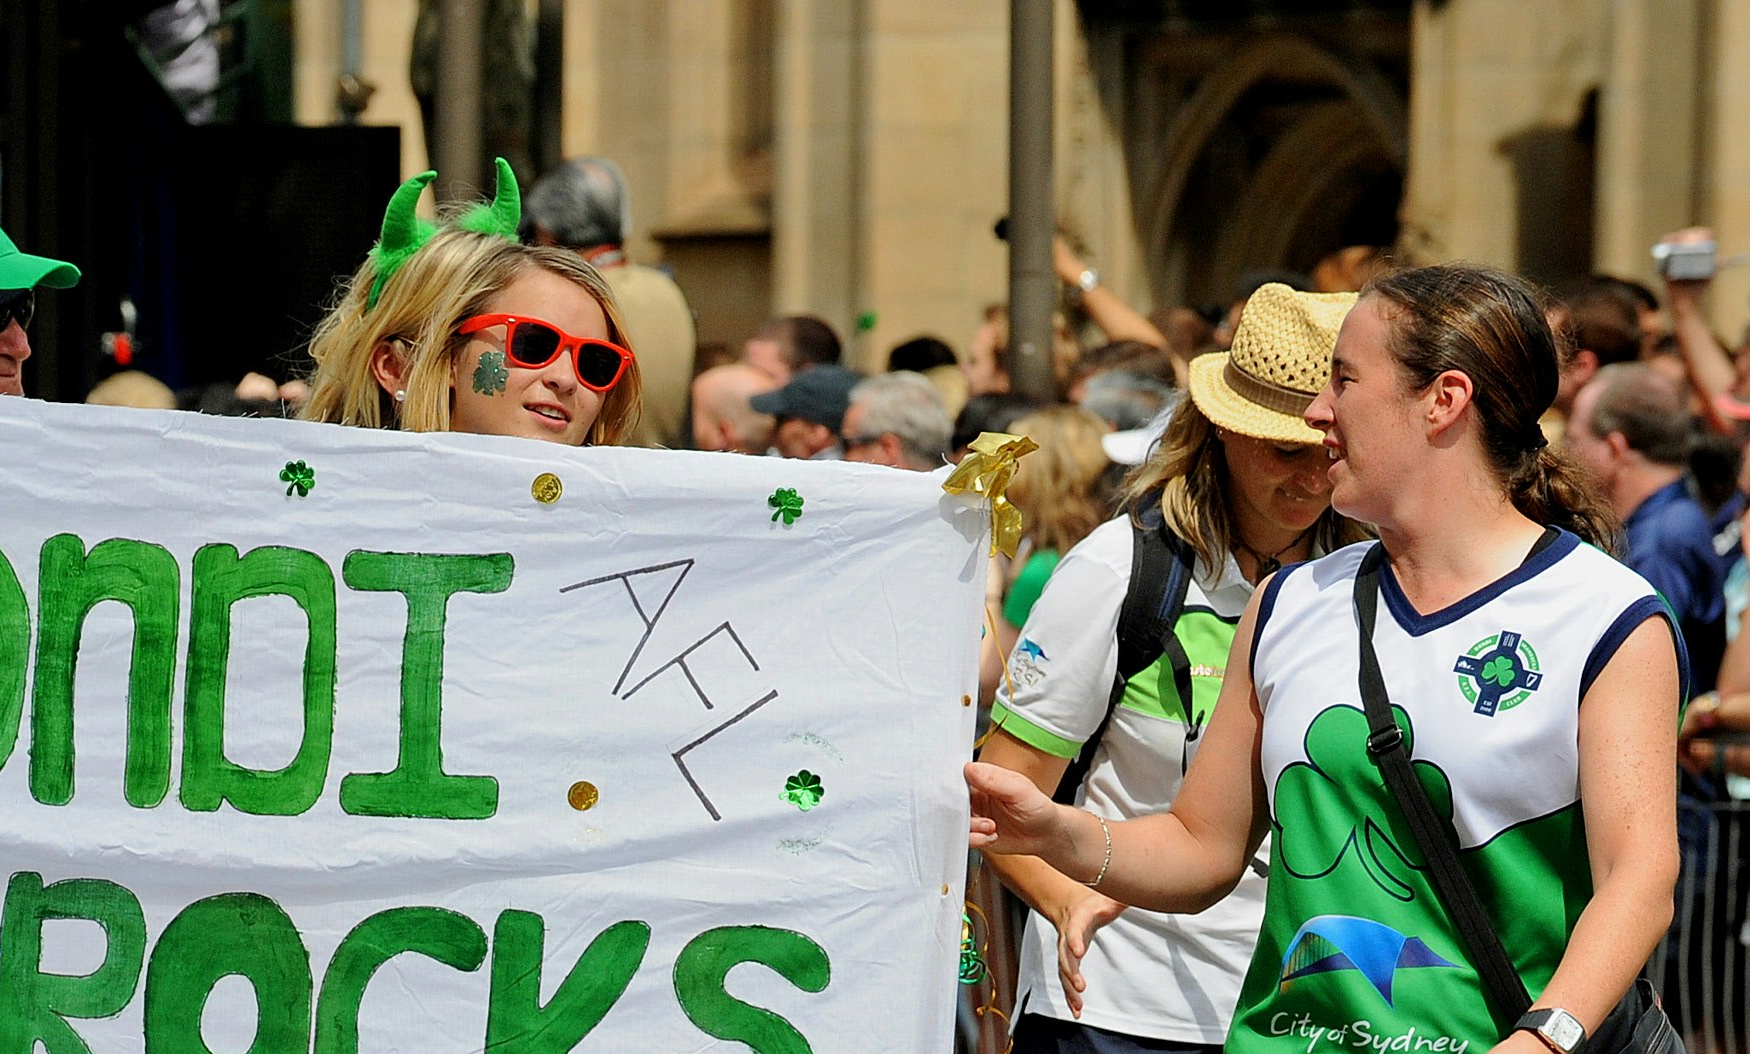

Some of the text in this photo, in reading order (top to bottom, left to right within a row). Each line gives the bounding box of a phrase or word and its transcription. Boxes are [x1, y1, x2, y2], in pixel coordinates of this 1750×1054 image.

[559, 557, 779, 822] AFL
[1270, 1012, 1325, 1054] City
[1327, 1024, 1349, 1045] of
